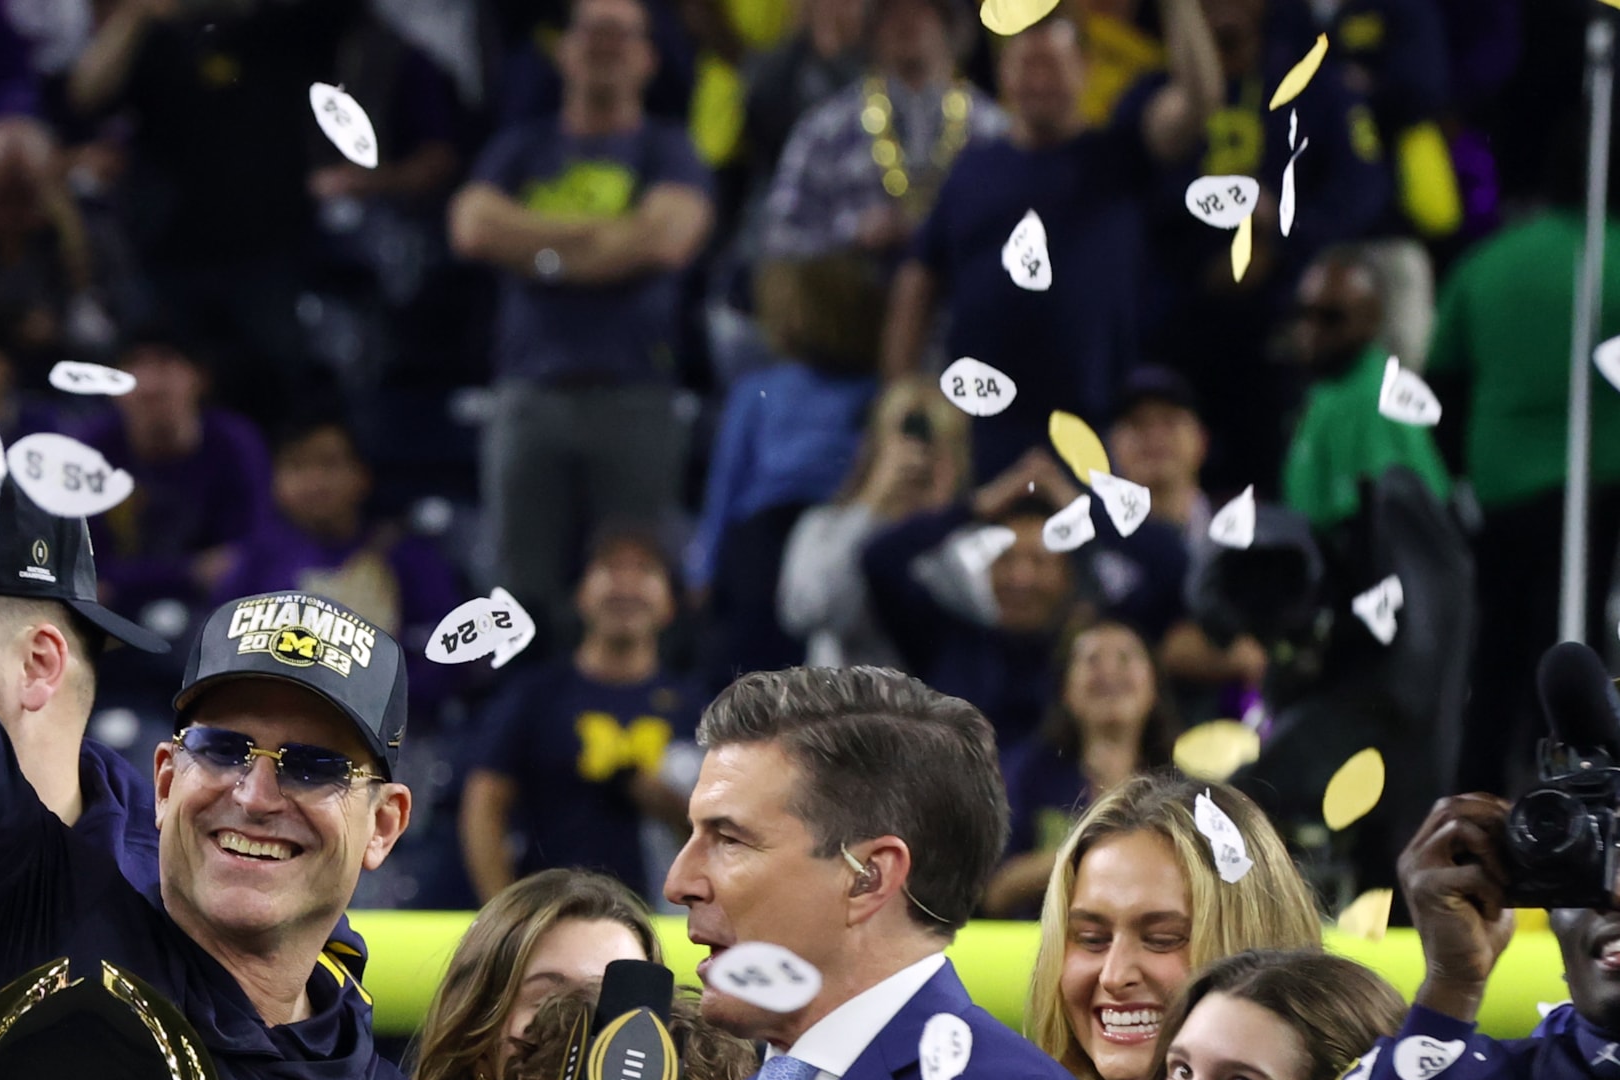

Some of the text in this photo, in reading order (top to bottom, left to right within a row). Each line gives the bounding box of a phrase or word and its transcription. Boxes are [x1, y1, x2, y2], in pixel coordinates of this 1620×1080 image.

[228, 602, 375, 668] CHAMPS
[238, 634, 270, 651] 20
[323, 647, 352, 676] 23
